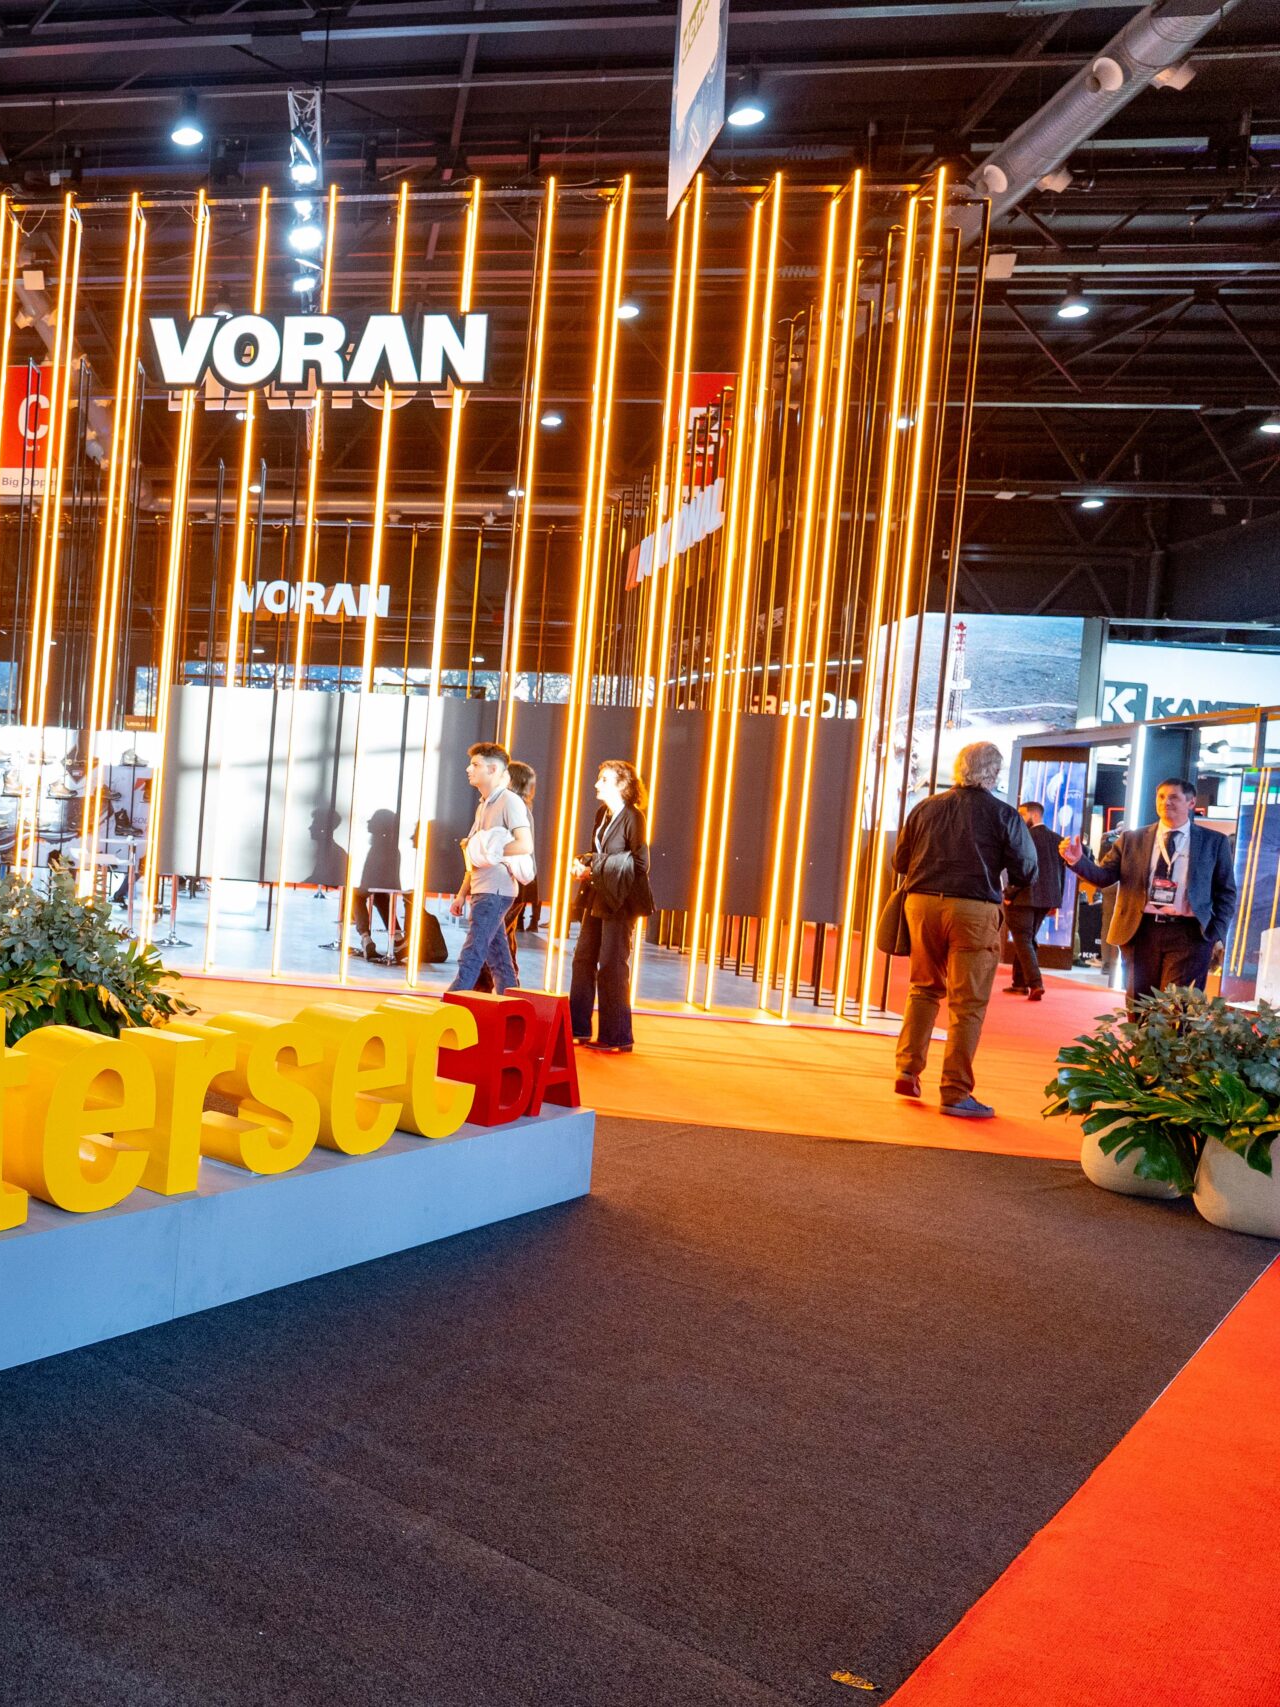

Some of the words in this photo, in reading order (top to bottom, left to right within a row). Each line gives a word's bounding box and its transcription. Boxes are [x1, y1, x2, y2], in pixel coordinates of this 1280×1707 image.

[149, 314, 488, 383] VORAN
[18, 394, 50, 440] C
[1, 477, 19, 488] Big
[237, 579, 391, 618] VORAN
